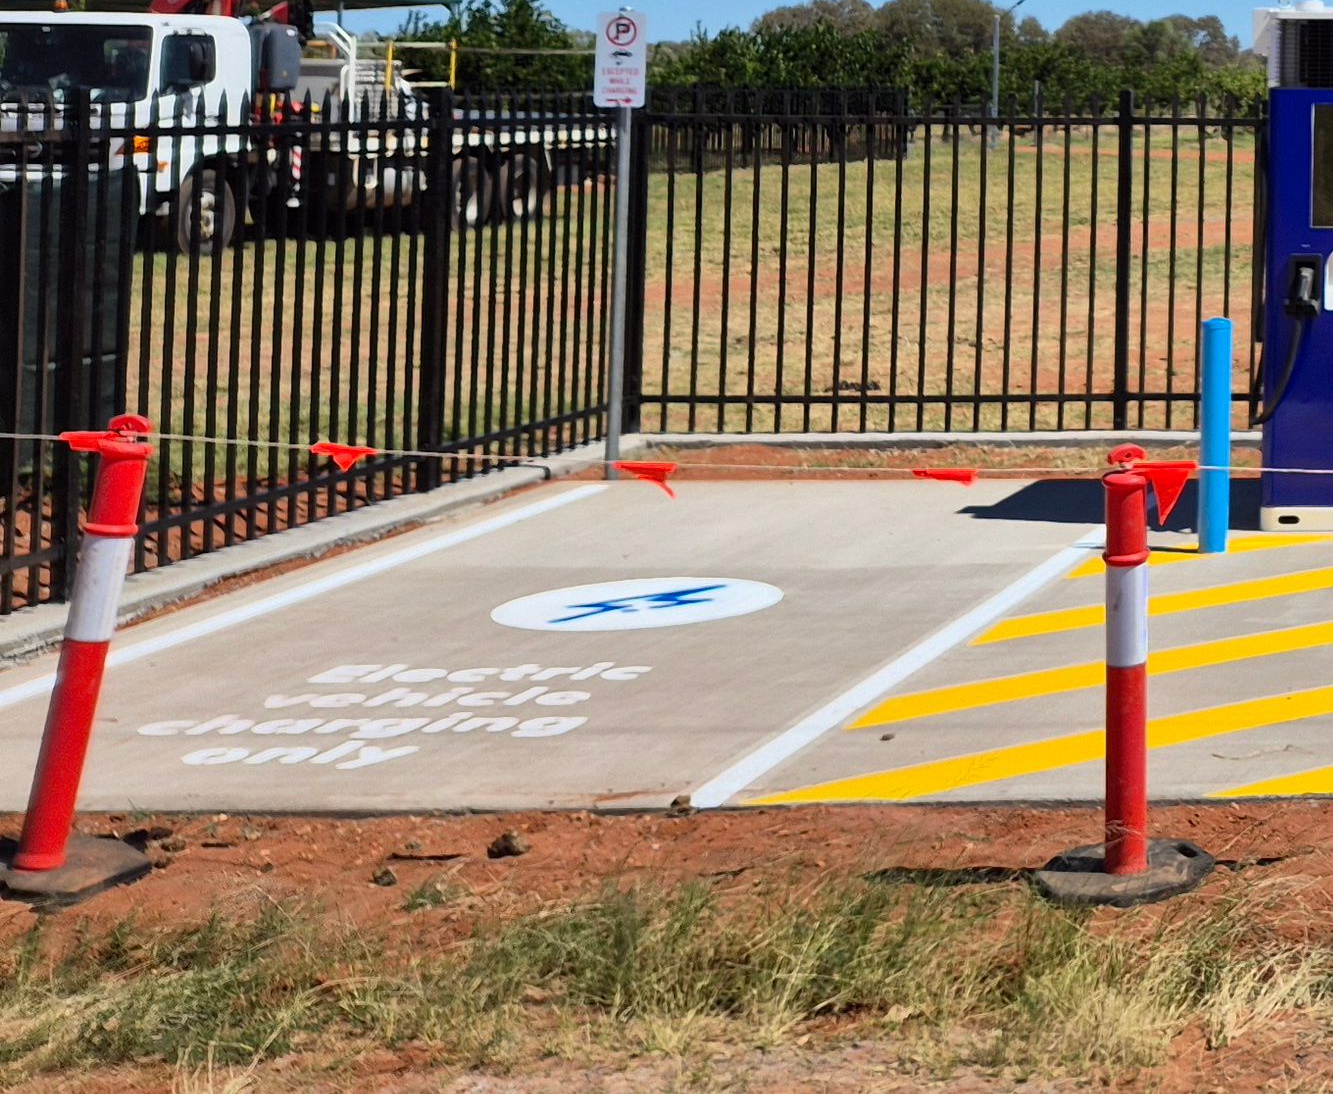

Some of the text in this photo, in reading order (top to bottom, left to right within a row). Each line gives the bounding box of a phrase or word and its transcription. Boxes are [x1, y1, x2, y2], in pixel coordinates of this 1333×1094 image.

[307, 662, 654, 684] Electric
[264, 687, 591, 708] vehicle
[137, 712, 588, 739] charging
[181, 740, 420, 770] only
